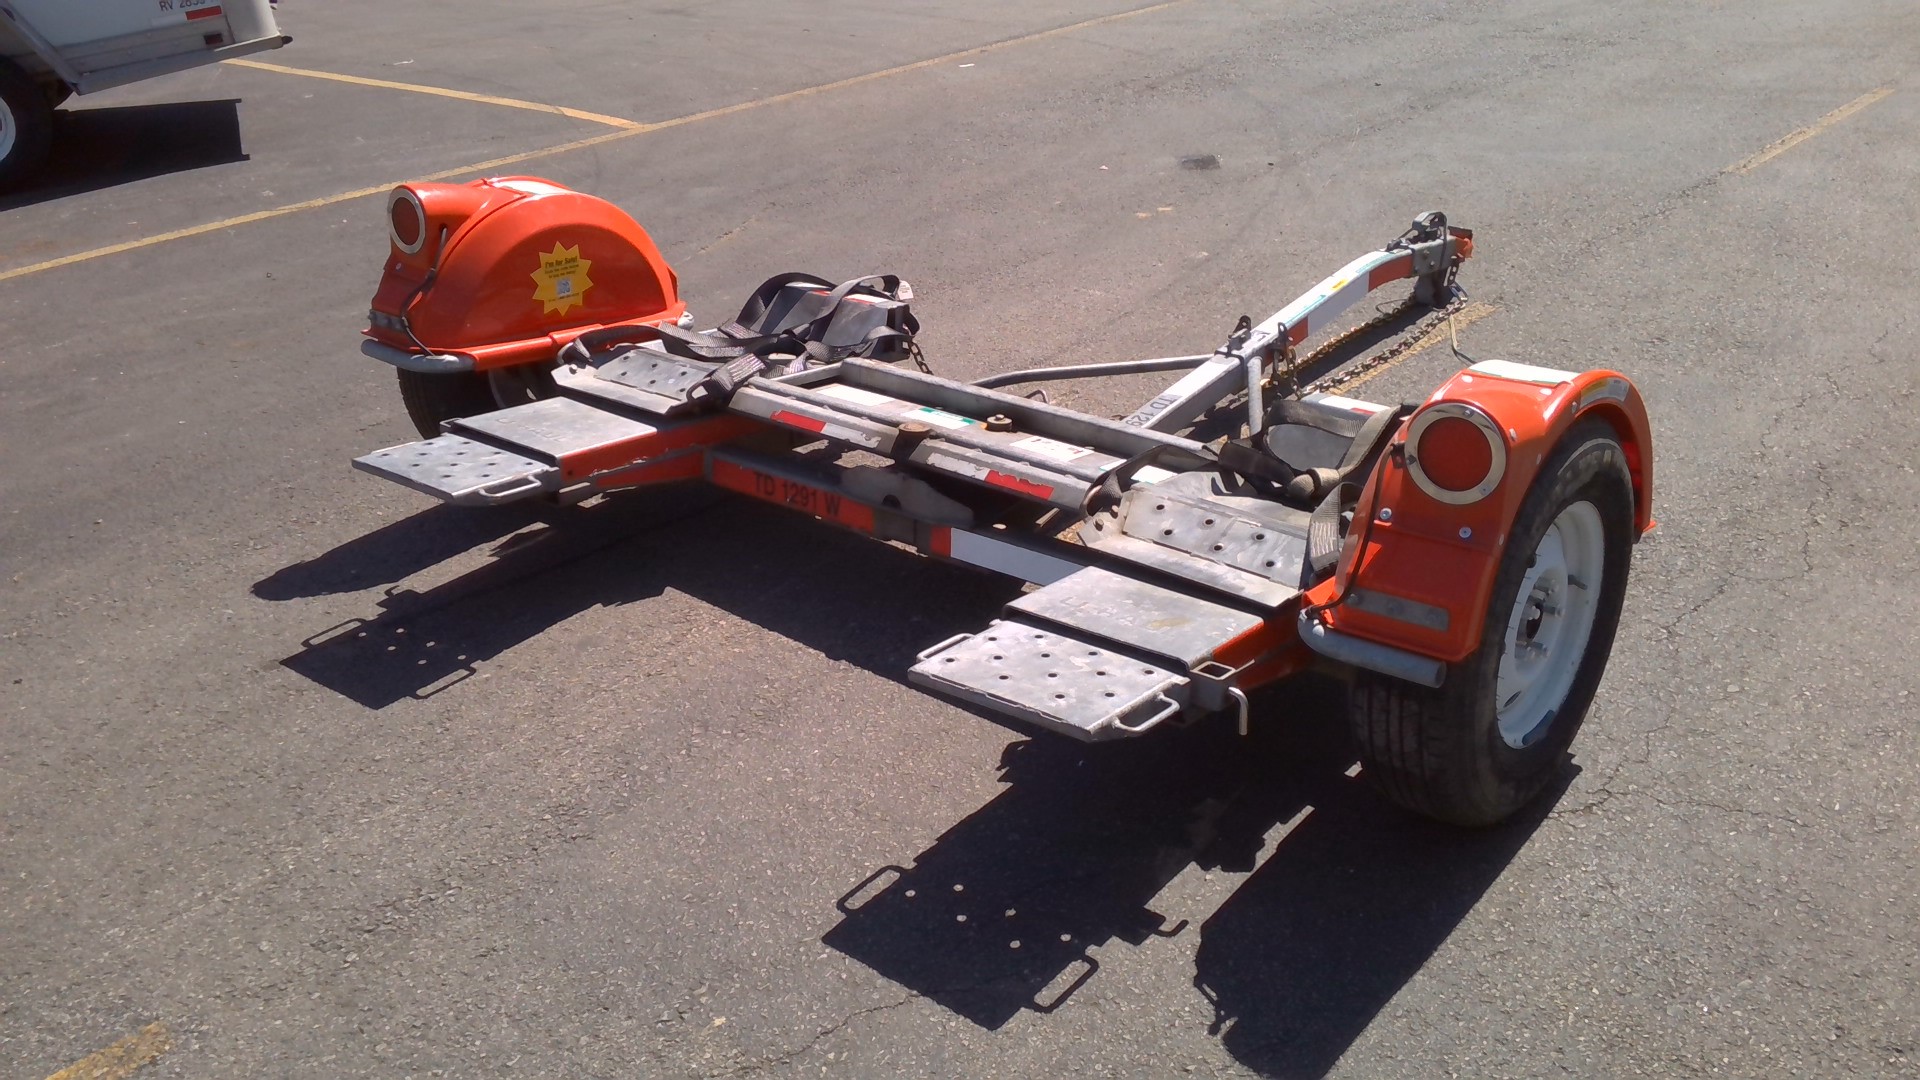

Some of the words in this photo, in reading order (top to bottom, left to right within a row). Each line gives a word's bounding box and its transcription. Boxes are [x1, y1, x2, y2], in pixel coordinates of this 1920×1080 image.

[159, 0, 174, 11] RV
[1150, 397, 1178, 410] TD
[753, 470, 776, 496] TD
[781, 480, 817, 511] 1291
[824, 491, 841, 516] W
